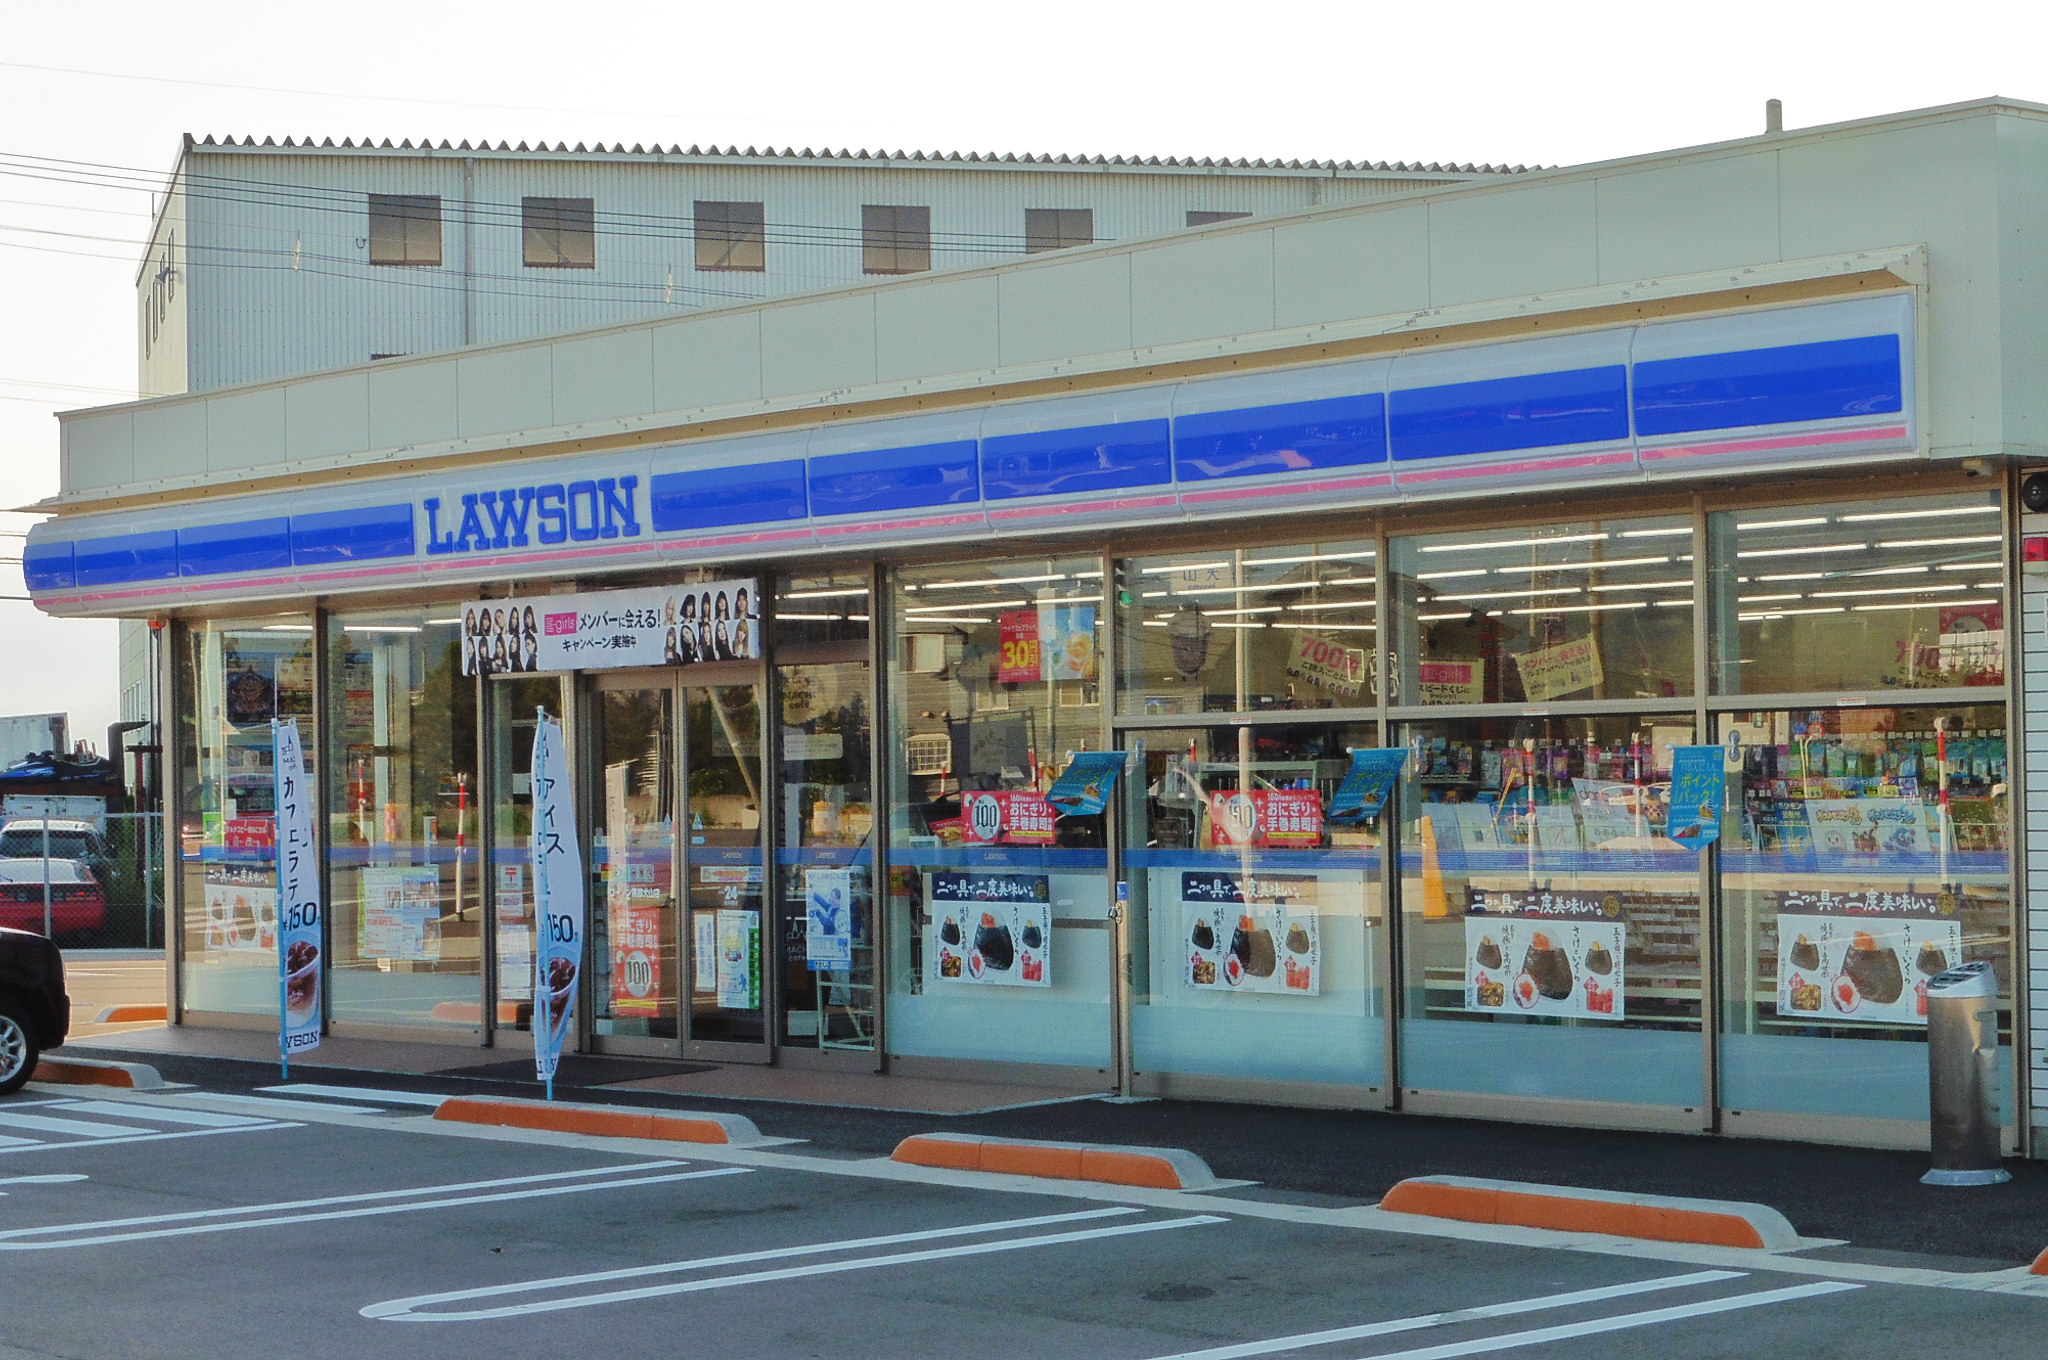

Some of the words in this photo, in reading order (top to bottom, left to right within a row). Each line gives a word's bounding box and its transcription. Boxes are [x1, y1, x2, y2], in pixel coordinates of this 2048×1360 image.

[424, 475, 641, 555] LAWSON
[284, 777, 300, 901] カフェラテ
[974, 804, 997, 828] 100
[627, 958, 650, 985] 100
